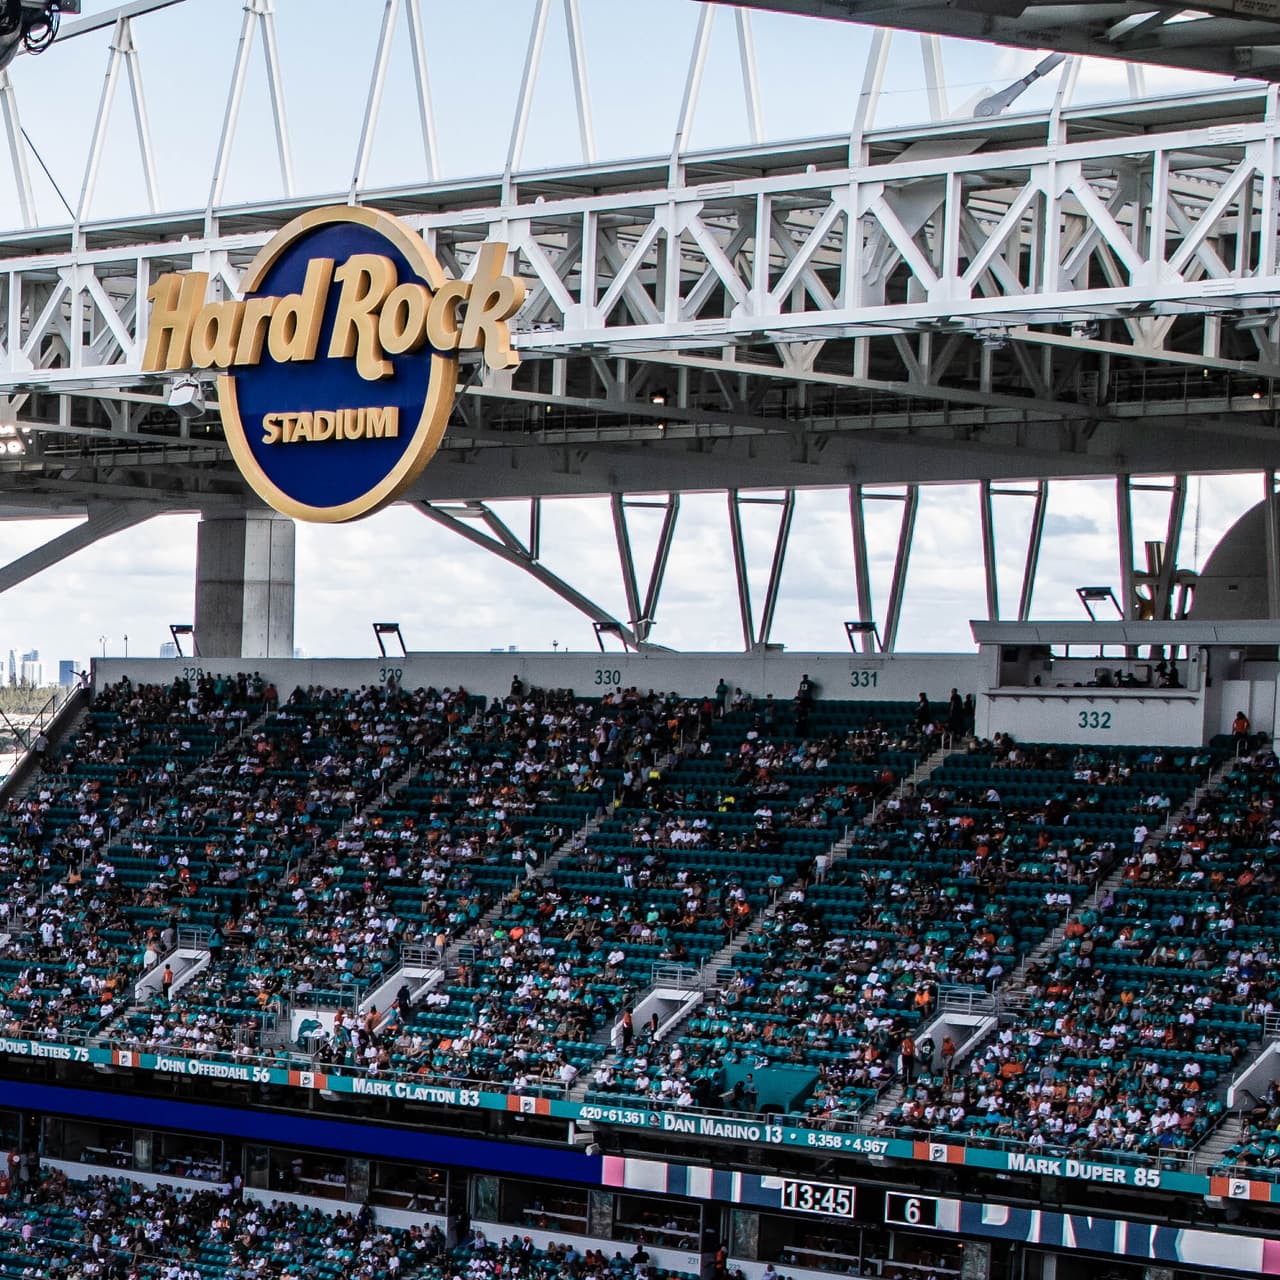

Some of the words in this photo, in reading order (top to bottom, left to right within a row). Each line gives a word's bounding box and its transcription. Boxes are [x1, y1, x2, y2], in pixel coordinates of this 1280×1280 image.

[142, 257, 336, 372] Hard
[328, 242, 525, 381] Rock
[261, 406, 399, 445] STADIUM
[595, 669, 621, 685] 330
[851, 672, 877, 686] 331
[1078, 711, 1111, 728] 332
[31, 1041, 71, 1059] BETTERS
[74, 1046, 89, 1062] 75
[155, 1057, 186, 1073] JOHN
[189, 1060, 249, 1081] OFFERDAHL
[252, 1067, 269, 1083] 56
[353, 1078, 392, 1096] MARK
[395, 1082, 456, 1103] CLAYTON
[459, 1090, 480, 1106] 83
[664, 1112, 696, 1133] DAN
[699, 1118, 760, 1141] MARINO
[765, 1125, 783, 1144] 13
[1008, 1153, 1061, 1176] MARK
[1065, 1159, 1126, 1184] DUPER
[1134, 1168, 1160, 1187] 85
[786, 1181, 850, 1214] 13:45
[904, 1199, 921, 1223] 6
